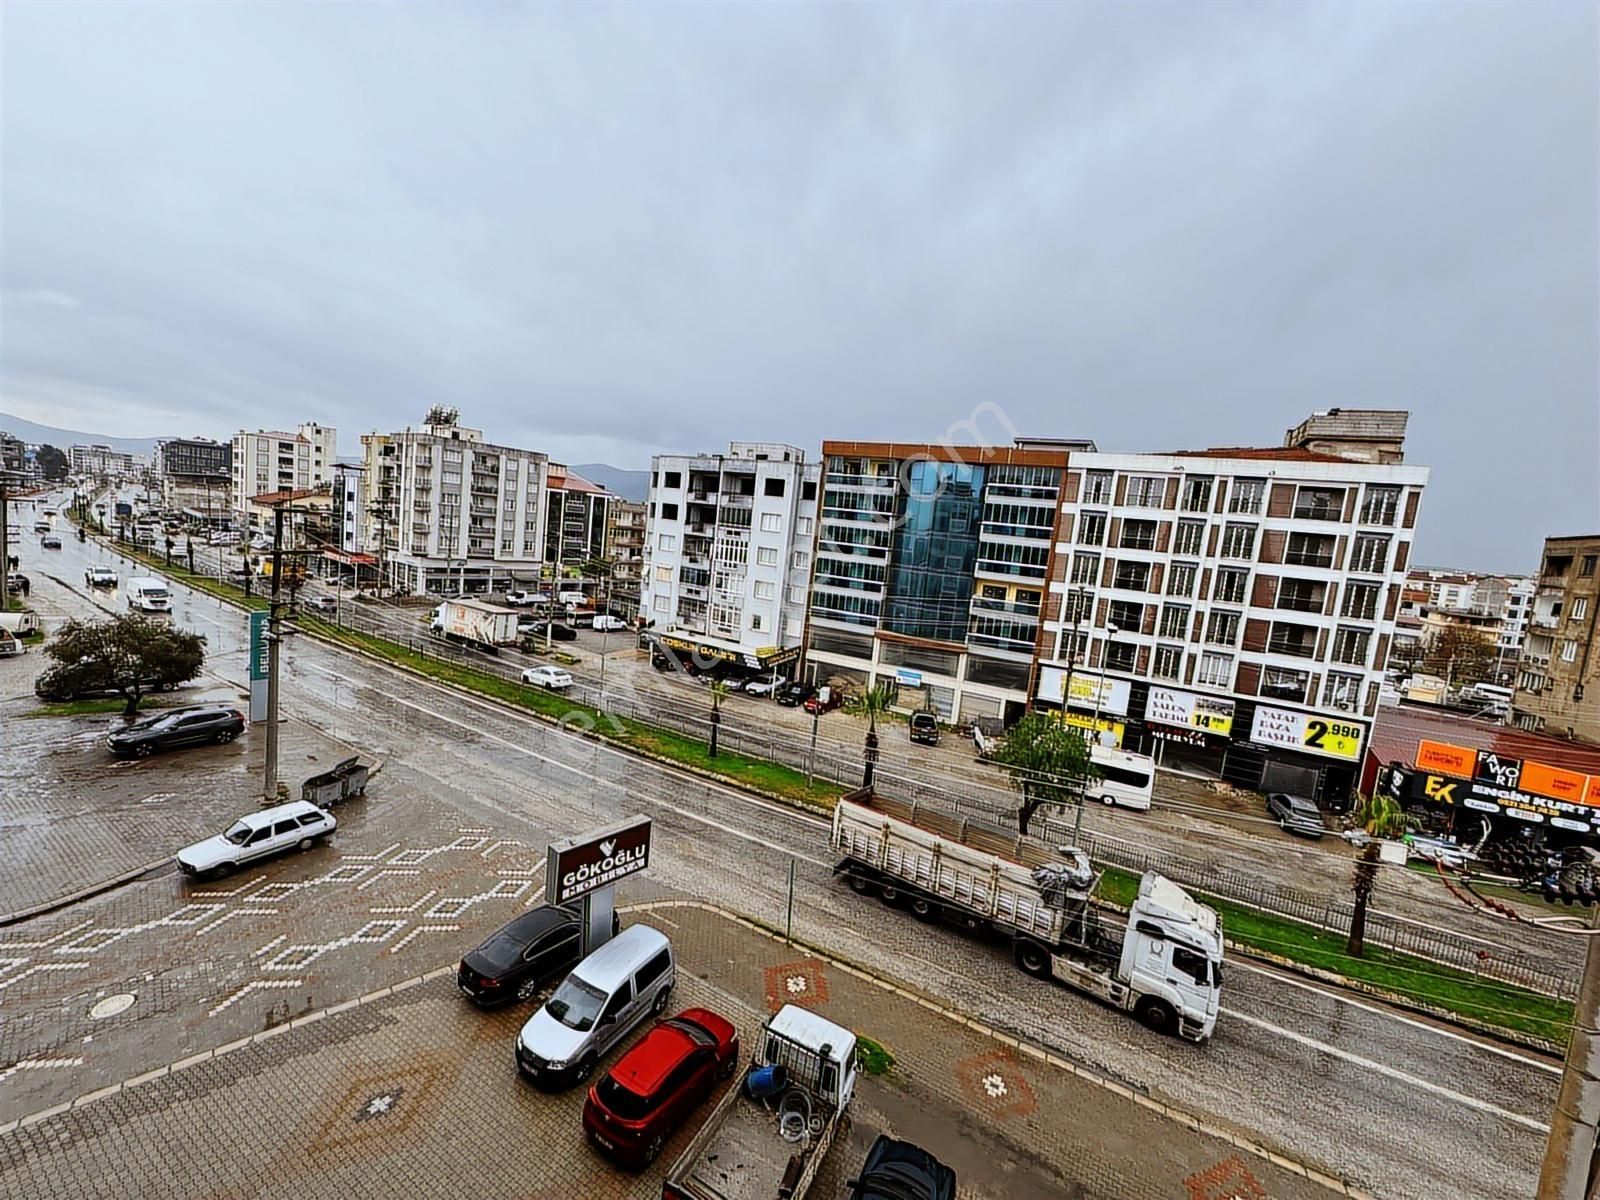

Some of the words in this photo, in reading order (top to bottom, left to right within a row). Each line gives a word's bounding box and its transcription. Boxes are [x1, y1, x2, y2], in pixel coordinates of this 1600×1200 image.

[1260, 719, 1291, 733] BAZA
[1262, 710, 1299, 724] YATAK
[1425, 775, 1458, 804] EK
[1472, 784, 1531, 804] ENGİN
[1532, 796, 1591, 815] KURT
[563, 844, 646, 887] GÖKOĞLU
